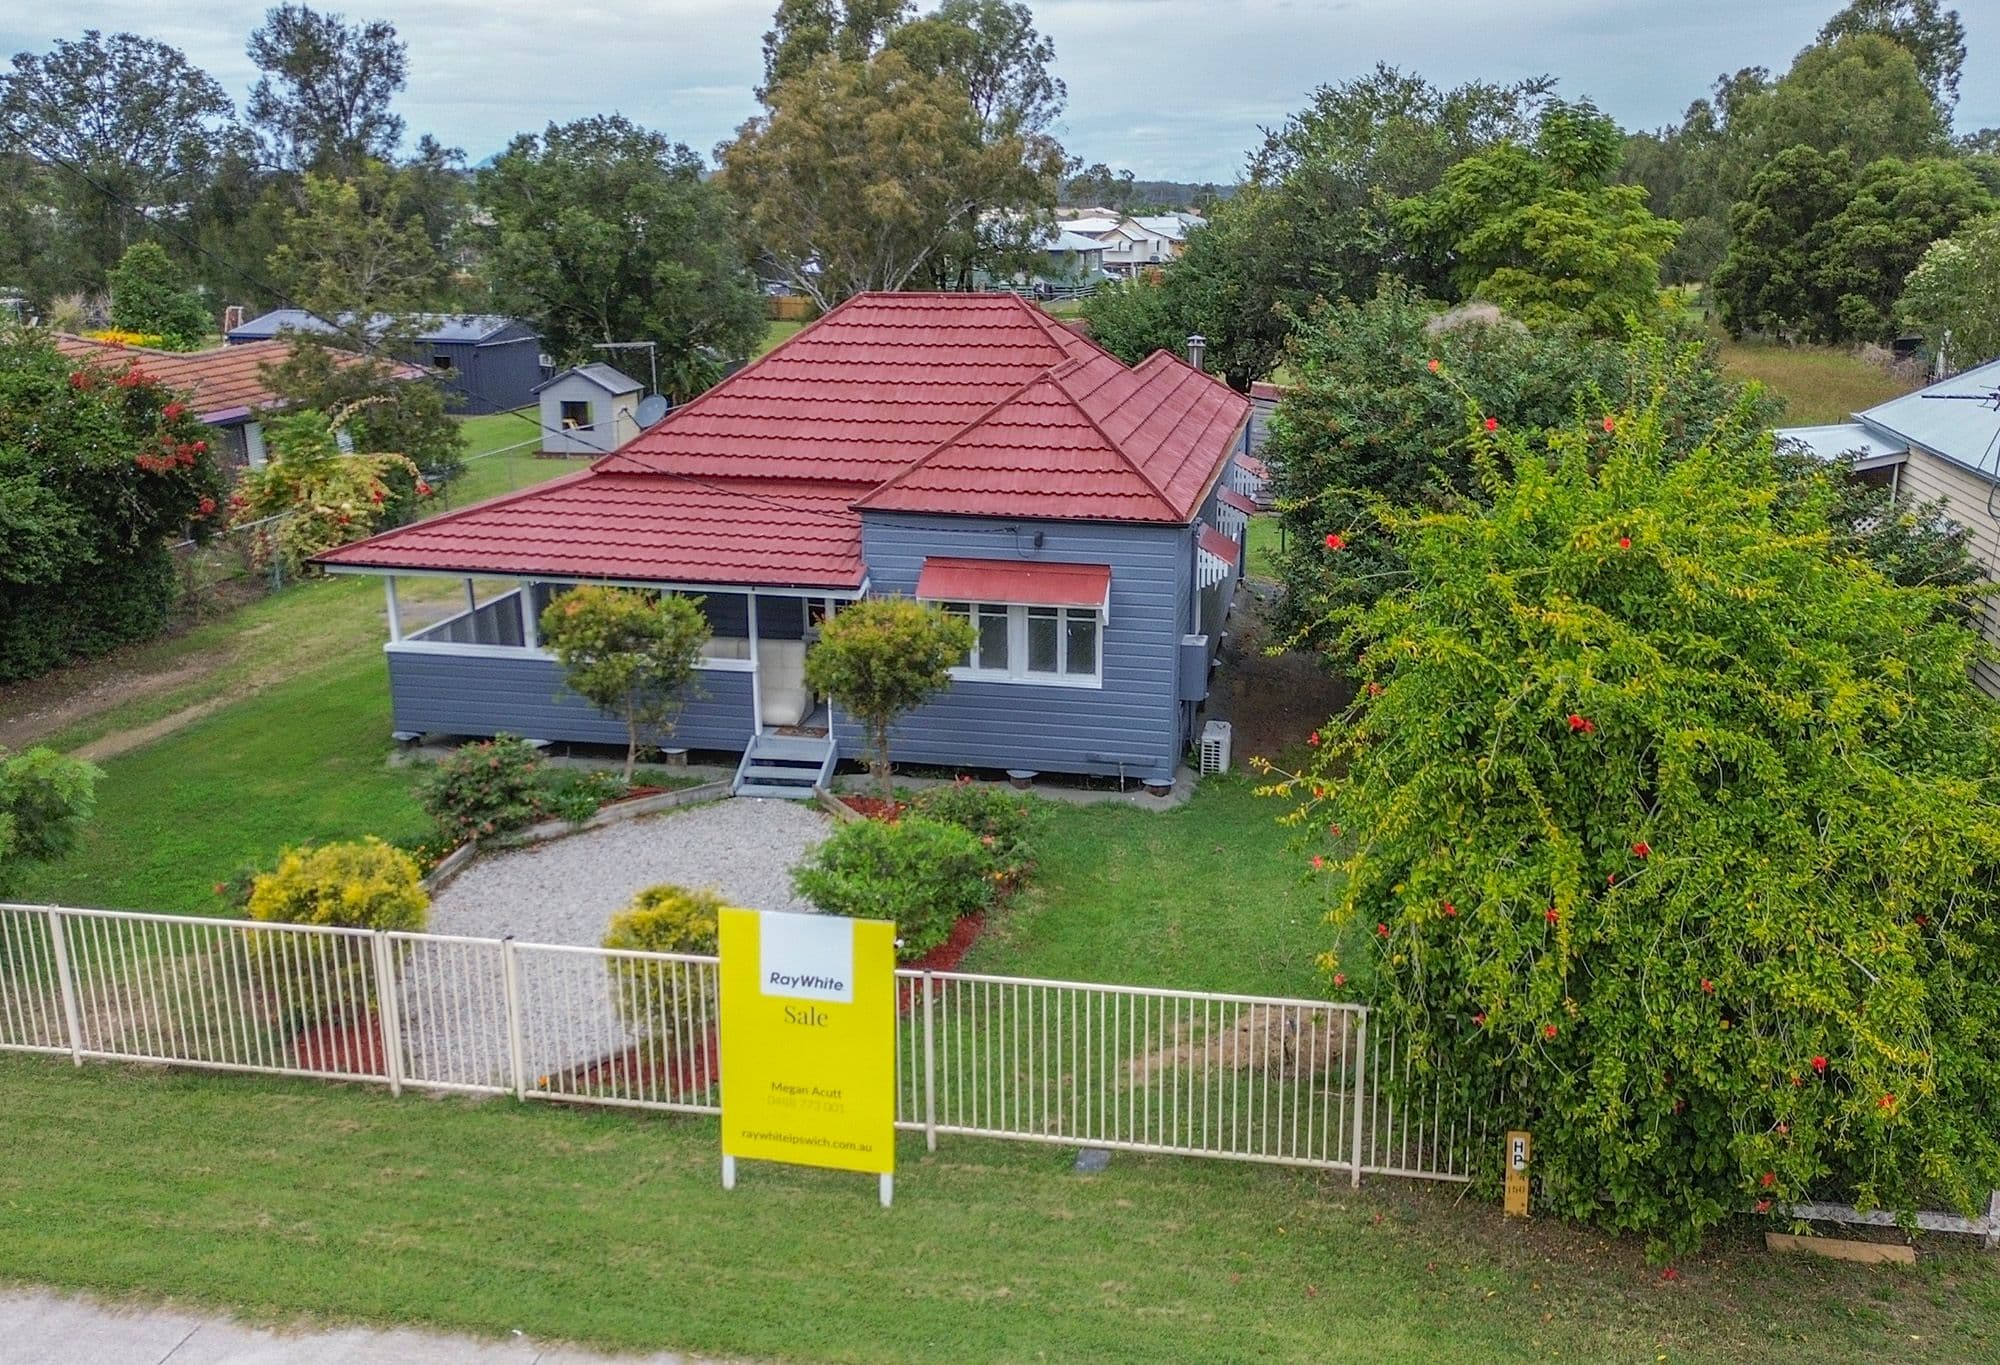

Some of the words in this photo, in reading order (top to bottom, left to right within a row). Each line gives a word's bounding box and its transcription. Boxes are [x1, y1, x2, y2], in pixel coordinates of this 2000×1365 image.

[770, 971, 844, 991] RayWhite
[783, 1005, 829, 1027] Sale
[771, 1081, 809, 1095] Megan
[811, 1086, 842, 1099] Acutt
[741, 1129, 873, 1152] raywhiteipswich.com.au
